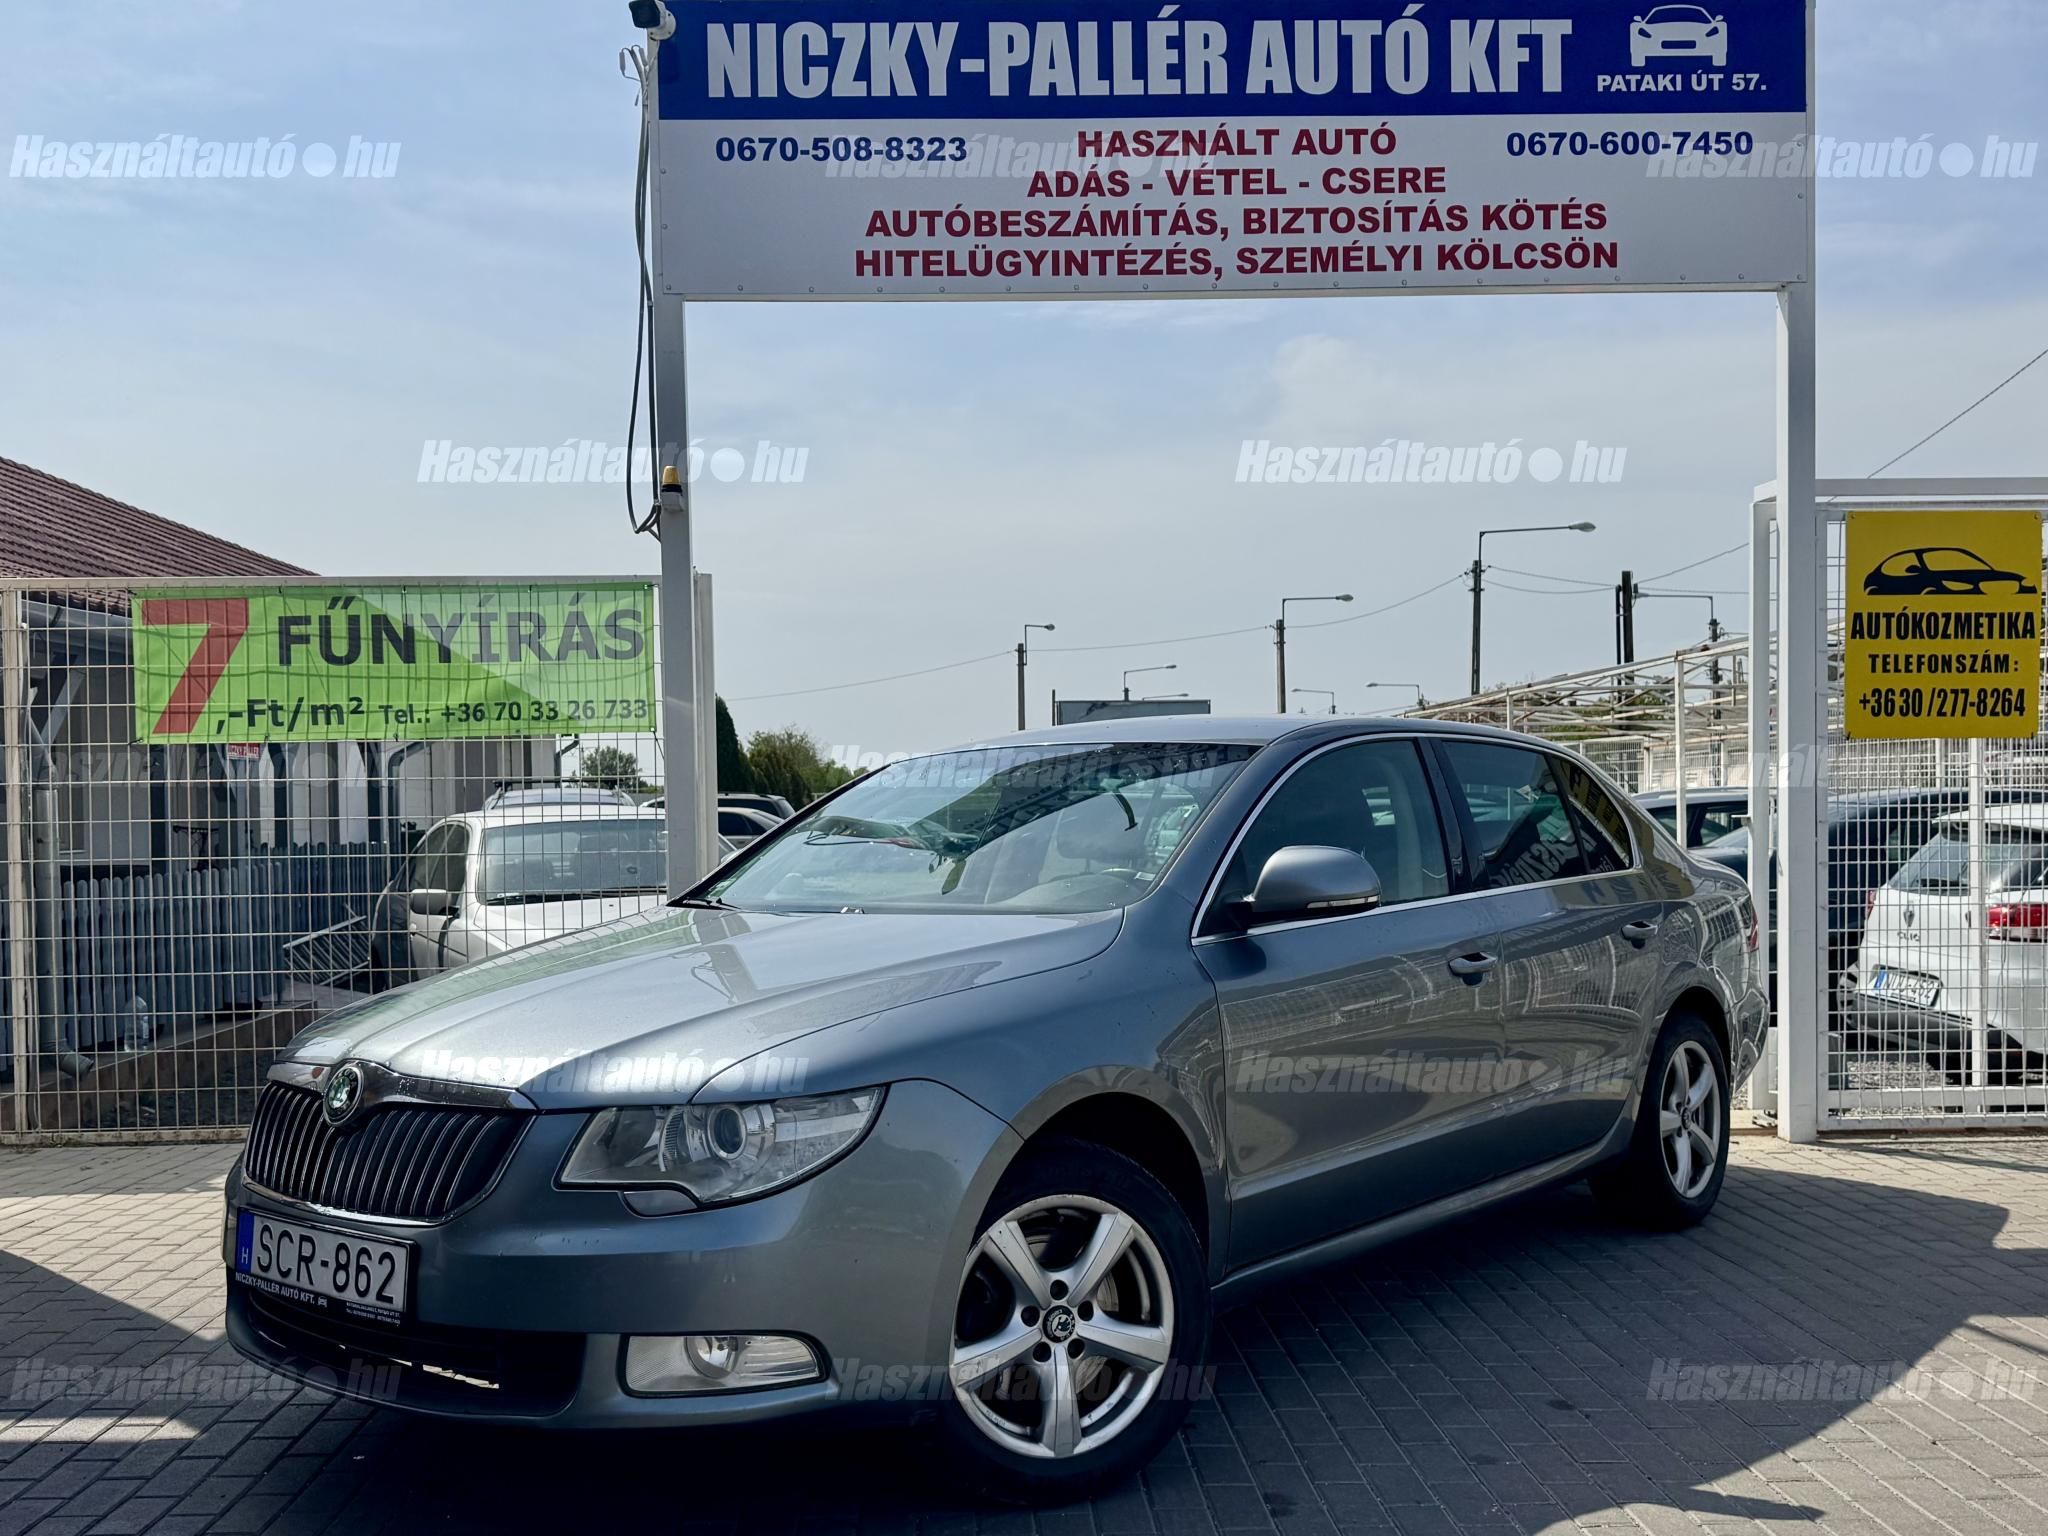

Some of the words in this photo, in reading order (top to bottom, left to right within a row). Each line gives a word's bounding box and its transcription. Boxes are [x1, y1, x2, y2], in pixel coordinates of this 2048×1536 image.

[707, 5, 1228, 98] NICZKY-PALLÉR
[1246, 4, 1429, 95] AUTÓ
[1451, 18, 1572, 93] KFT
[1597, 74, 1682, 92] PATAKI
[1691, 70, 1724, 91] ÚT
[1732, 73, 1767, 91] 57.
[715, 136, 967, 162] 0670-508-8323
[1078, 123, 1279, 157] HASZNÁLT
[1292, 122, 1396, 155] AUTÓ
[1506, 131, 1754, 157] 0670-600-7450
[1027, 164, 1130, 197] ADÁS
[1165, 163, 1287, 195] VÉTEL
[1322, 166, 1446, 194] CSERE
[865, 203, 1229, 242] AUTÓBESZÁMÍTÁS,
[1243, 199, 1468, 234] BIZTOSÍTÁS
[1482, 197, 1607, 231] KÖTÉS
[856, 242, 1223, 281] HITELÜGYINTÉZÉS,
[1236, 239, 1423, 273] SZEMÉLYI
[1437, 238, 1619, 270] KÖLCSÖN
[278, 592, 645, 667] FŰNYÍRÁS
[1850, 606, 2036, 641] AUTÓKOZMETIKA
[142, 597, 249, 735] 7
[378, 703, 431, 725] Tel.:
[441, 702, 486, 723] +36
[494, 701, 522, 722] 70
[530, 700, 559, 721] 33
[568, 699, 596, 720] 26
[604, 698, 648, 719] 733
[241, 1247, 249, 1264] H
[257, 1224, 396, 1305] SCR-862
